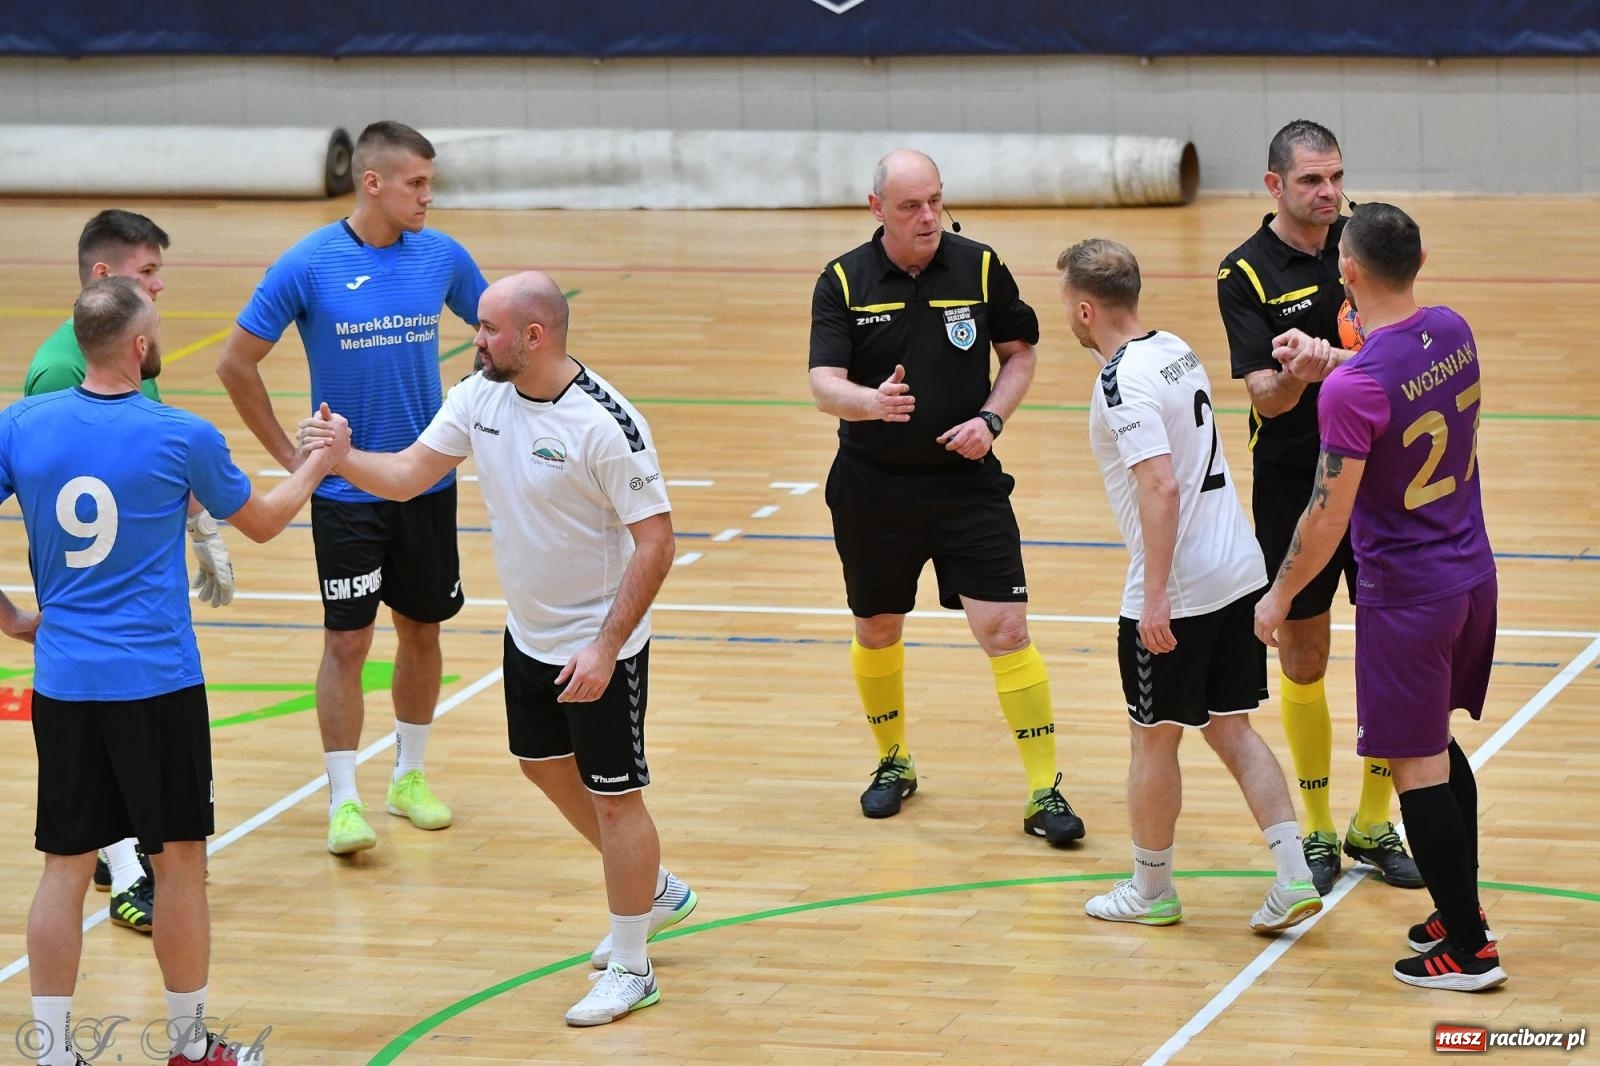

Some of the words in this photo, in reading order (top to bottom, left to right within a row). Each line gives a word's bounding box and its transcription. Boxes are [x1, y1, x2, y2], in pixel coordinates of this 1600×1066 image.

[856, 313, 892, 326] zina
[340, 335, 402, 351] Metallbau
[1400, 341, 1476, 402] WOŹNIAK
[1118, 420, 1141, 435] SPORT
[1193, 388, 1226, 494] 2
[1402, 378, 1481, 511] 27
[55, 475, 119, 569] 9
[324, 578, 351, 600] LSM
